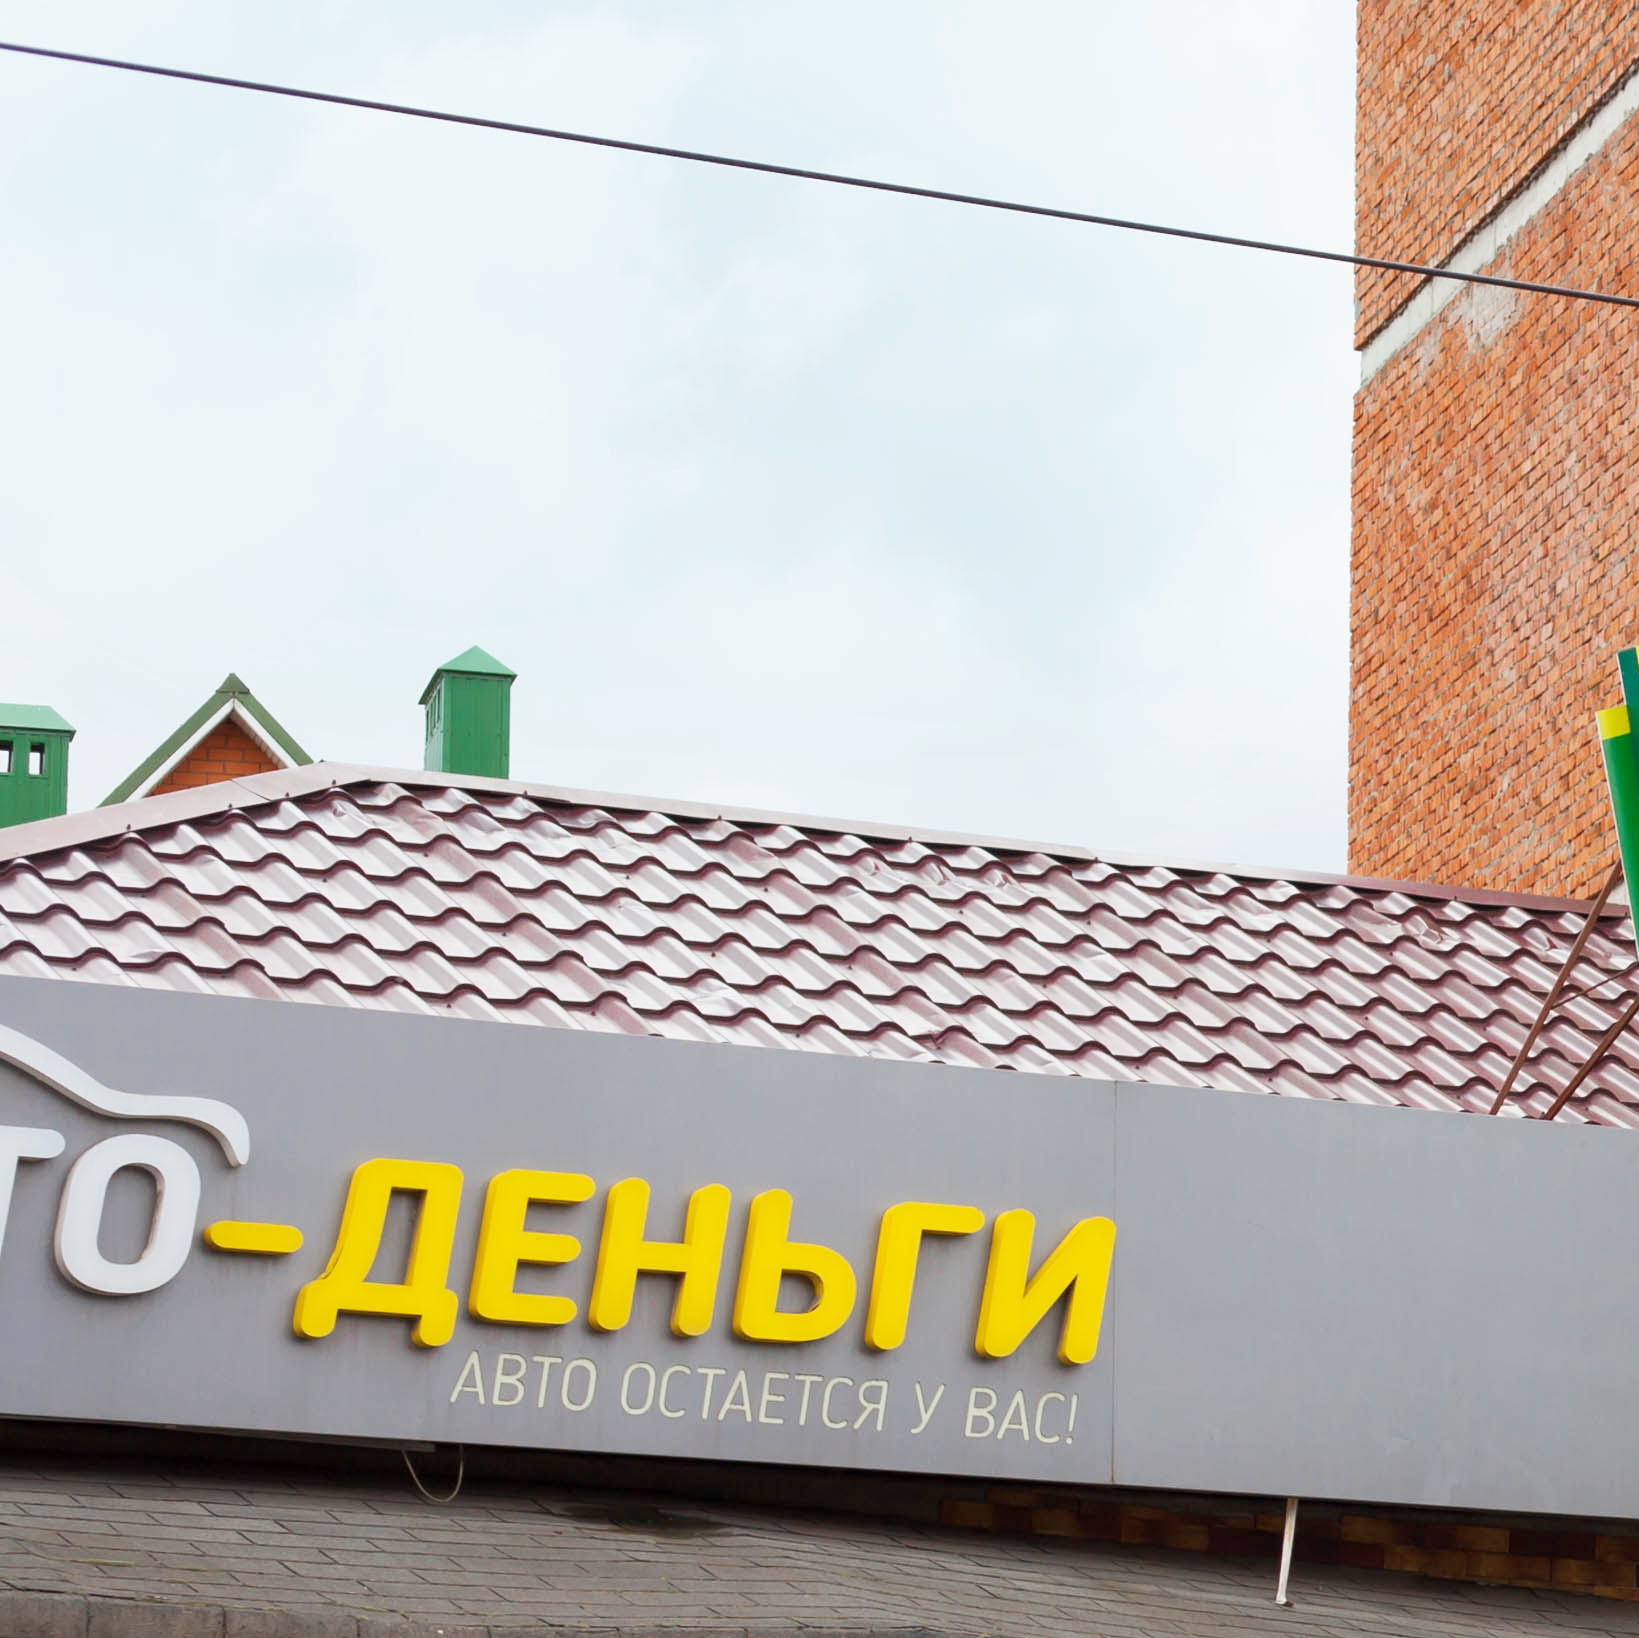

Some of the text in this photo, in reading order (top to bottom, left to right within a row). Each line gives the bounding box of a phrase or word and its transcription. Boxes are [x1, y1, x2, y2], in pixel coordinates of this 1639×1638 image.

[451, 1351, 1078, 1445] АВТО ОСТАЕТСЯ У ВАС!
